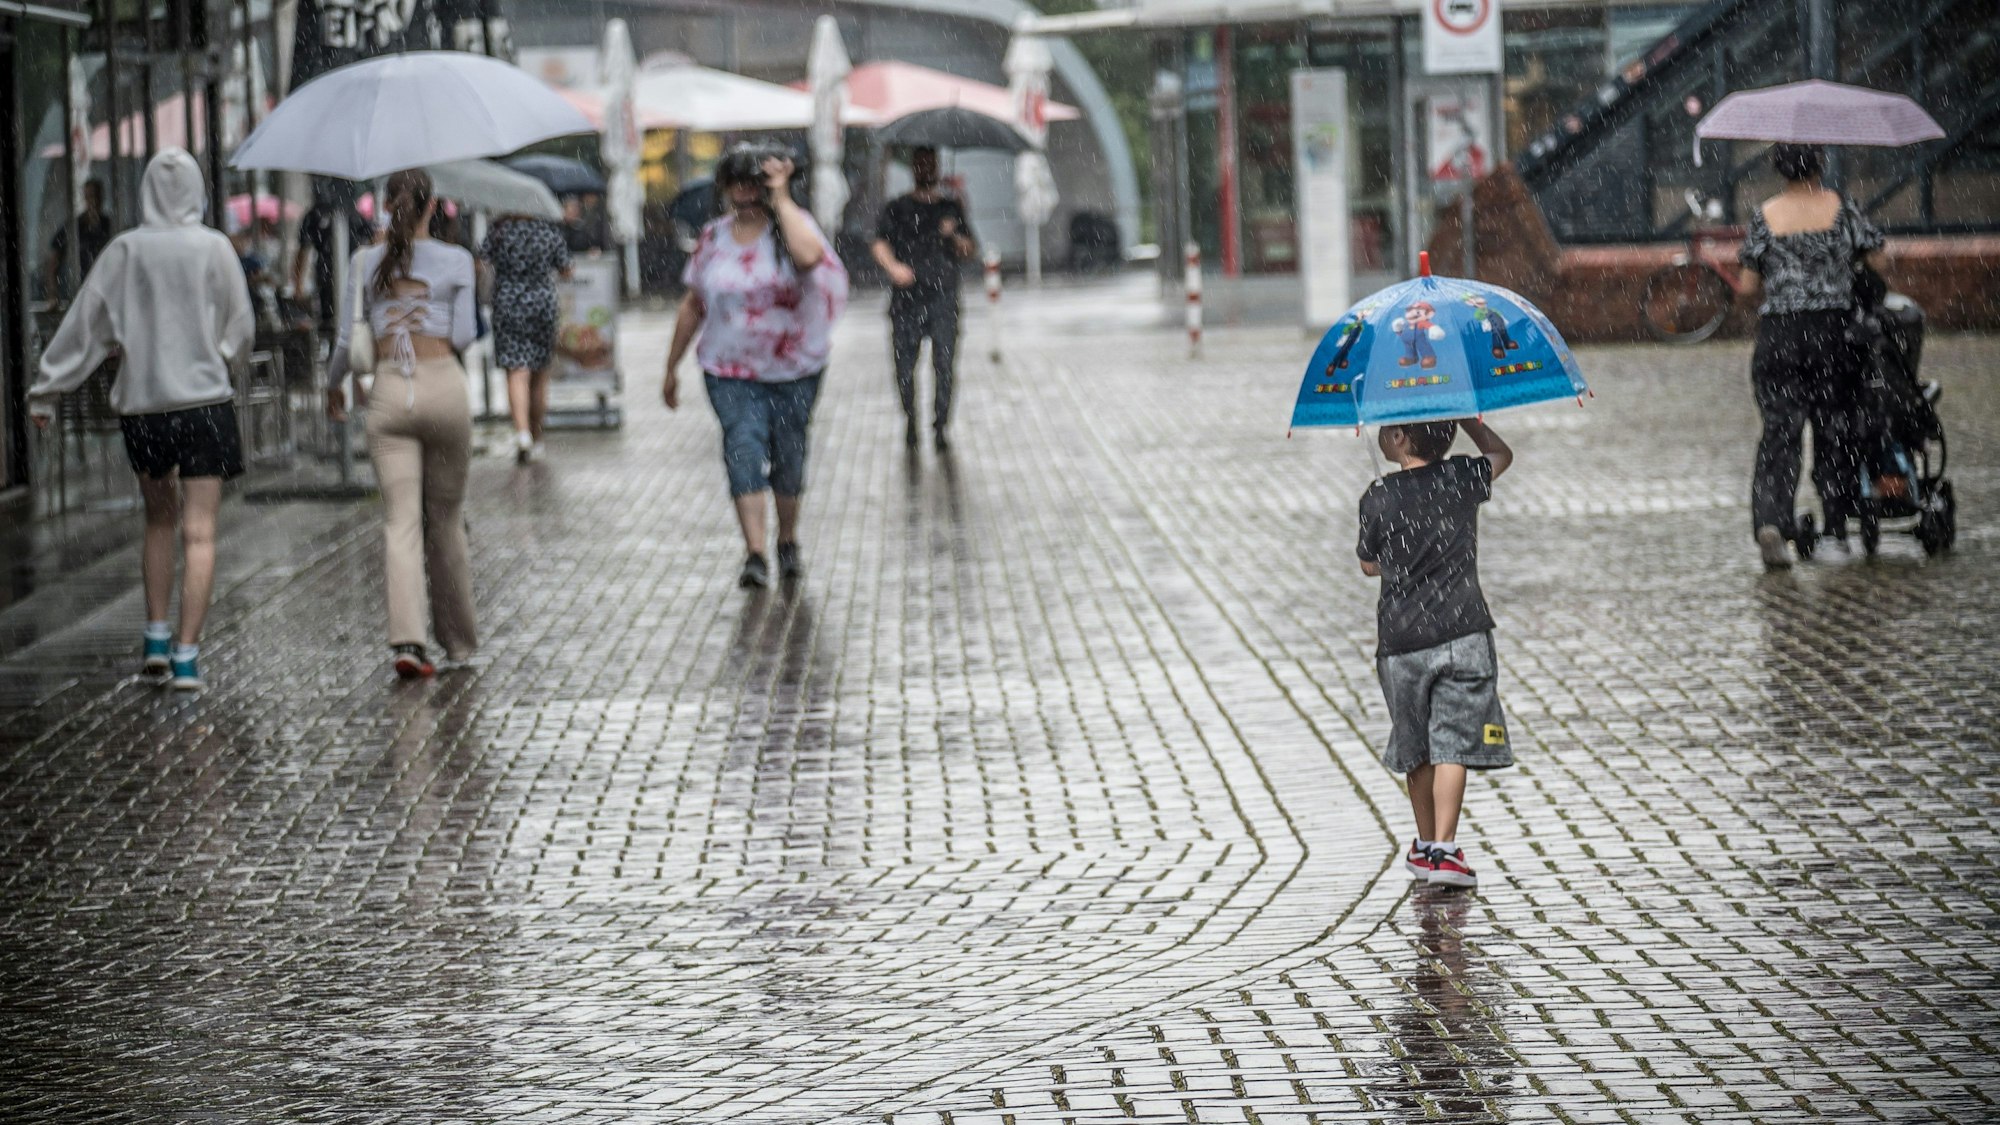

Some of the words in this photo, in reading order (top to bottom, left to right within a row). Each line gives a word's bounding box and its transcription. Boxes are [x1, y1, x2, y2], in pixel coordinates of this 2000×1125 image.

[1489, 365, 1516, 377] SUPER
[1516, 360, 1543, 373] MARIO
[1384, 376, 1416, 389] SUPER
[1417, 375, 1450, 385] MARIO
